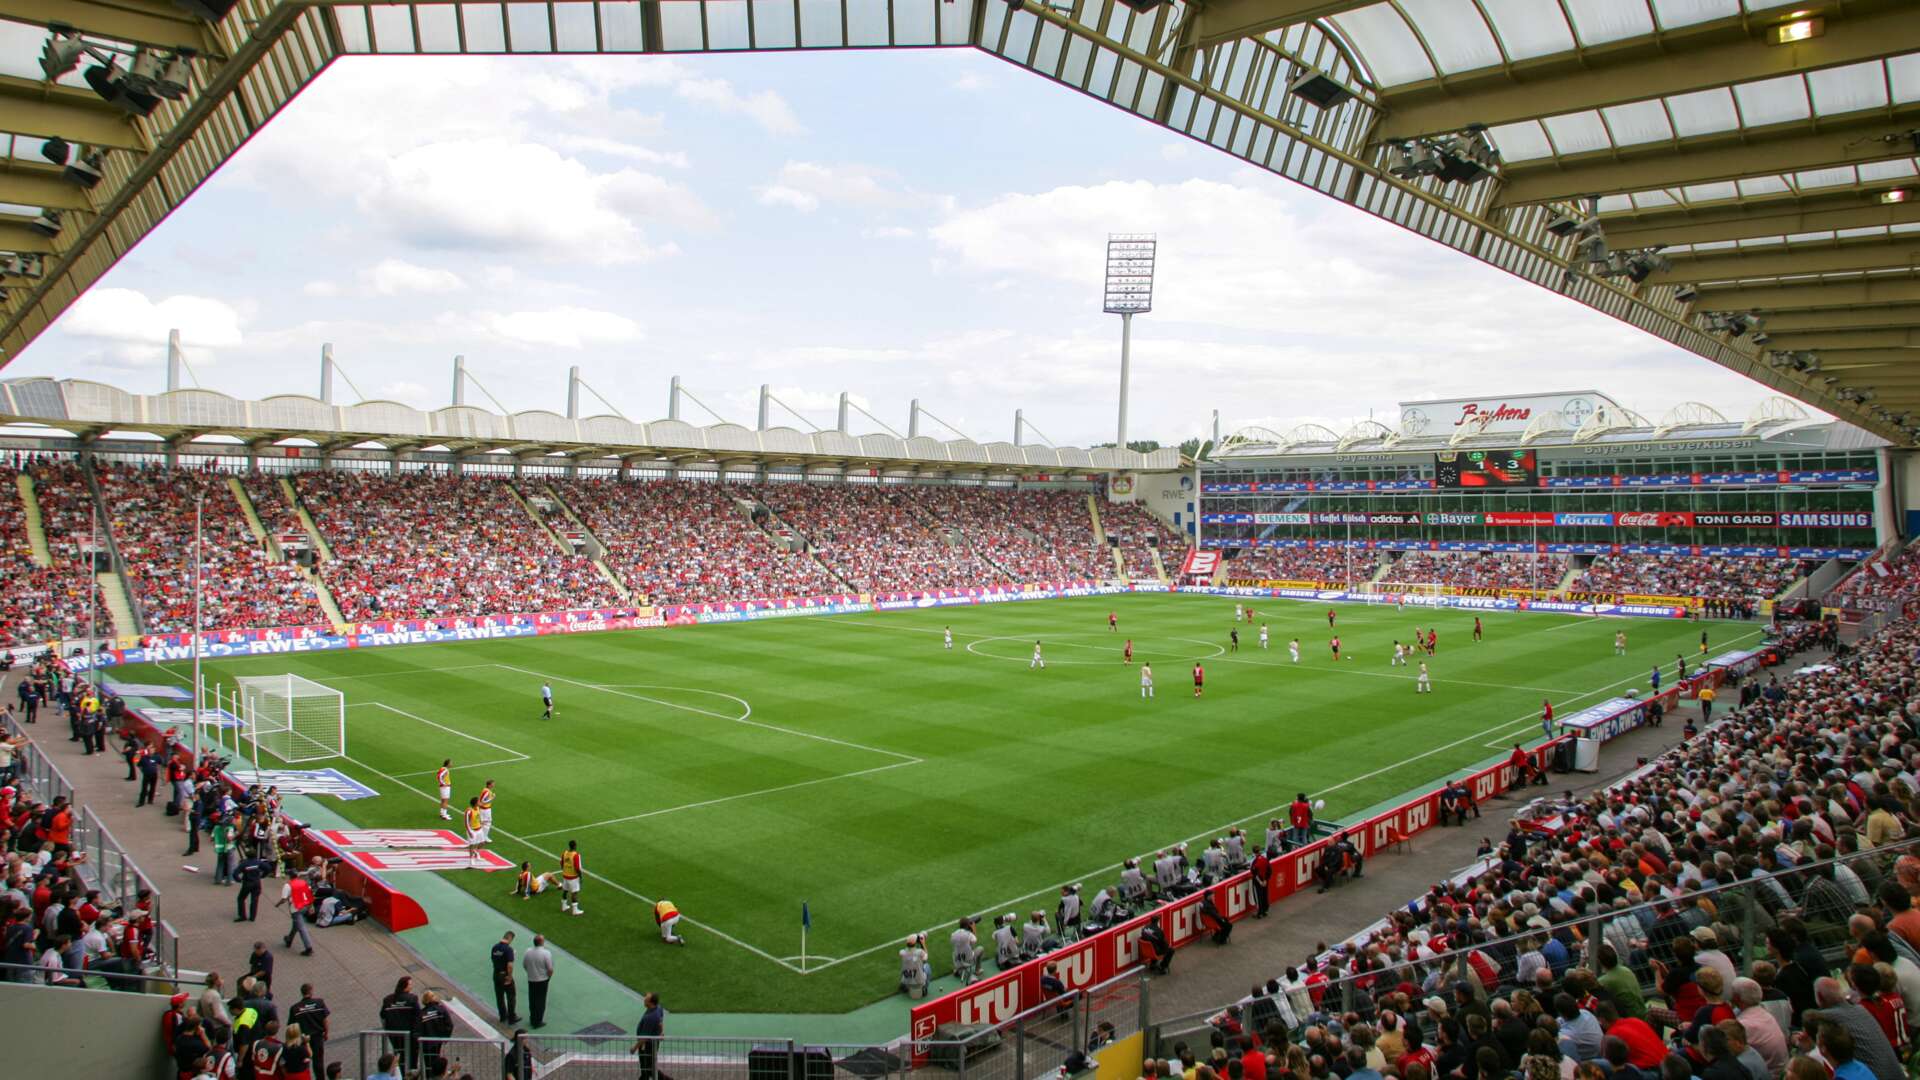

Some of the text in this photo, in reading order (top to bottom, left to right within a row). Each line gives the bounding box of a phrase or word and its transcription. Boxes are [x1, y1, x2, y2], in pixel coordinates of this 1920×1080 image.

[1507, 460, 1519, 469] 3
[1162, 490, 1184, 499] RWE
[1259, 514, 1306, 522] SIEMENS
[1370, 515, 1404, 523] adidas
[1441, 513, 1477, 525] Bayer
[1696, 516, 1772, 524] TONI GARD
[1781, 514, 1867, 526] SAMSUNG
[1459, 597, 1495, 608] RWE
[1531, 602, 1577, 610] SAMSUNG
[1620, 606, 1669, 615] SAMSUNG
[373, 631, 427, 645] RWE
[457, 626, 506, 640] RWE
[251, 639, 311, 653] RWE
[144, 644, 210, 662] RWE
[1476, 772, 1495, 800] LTU
[1407, 801, 1430, 833] LTU
[1043, 947, 1093, 998] TU
[961, 980, 1019, 1026] LTU
